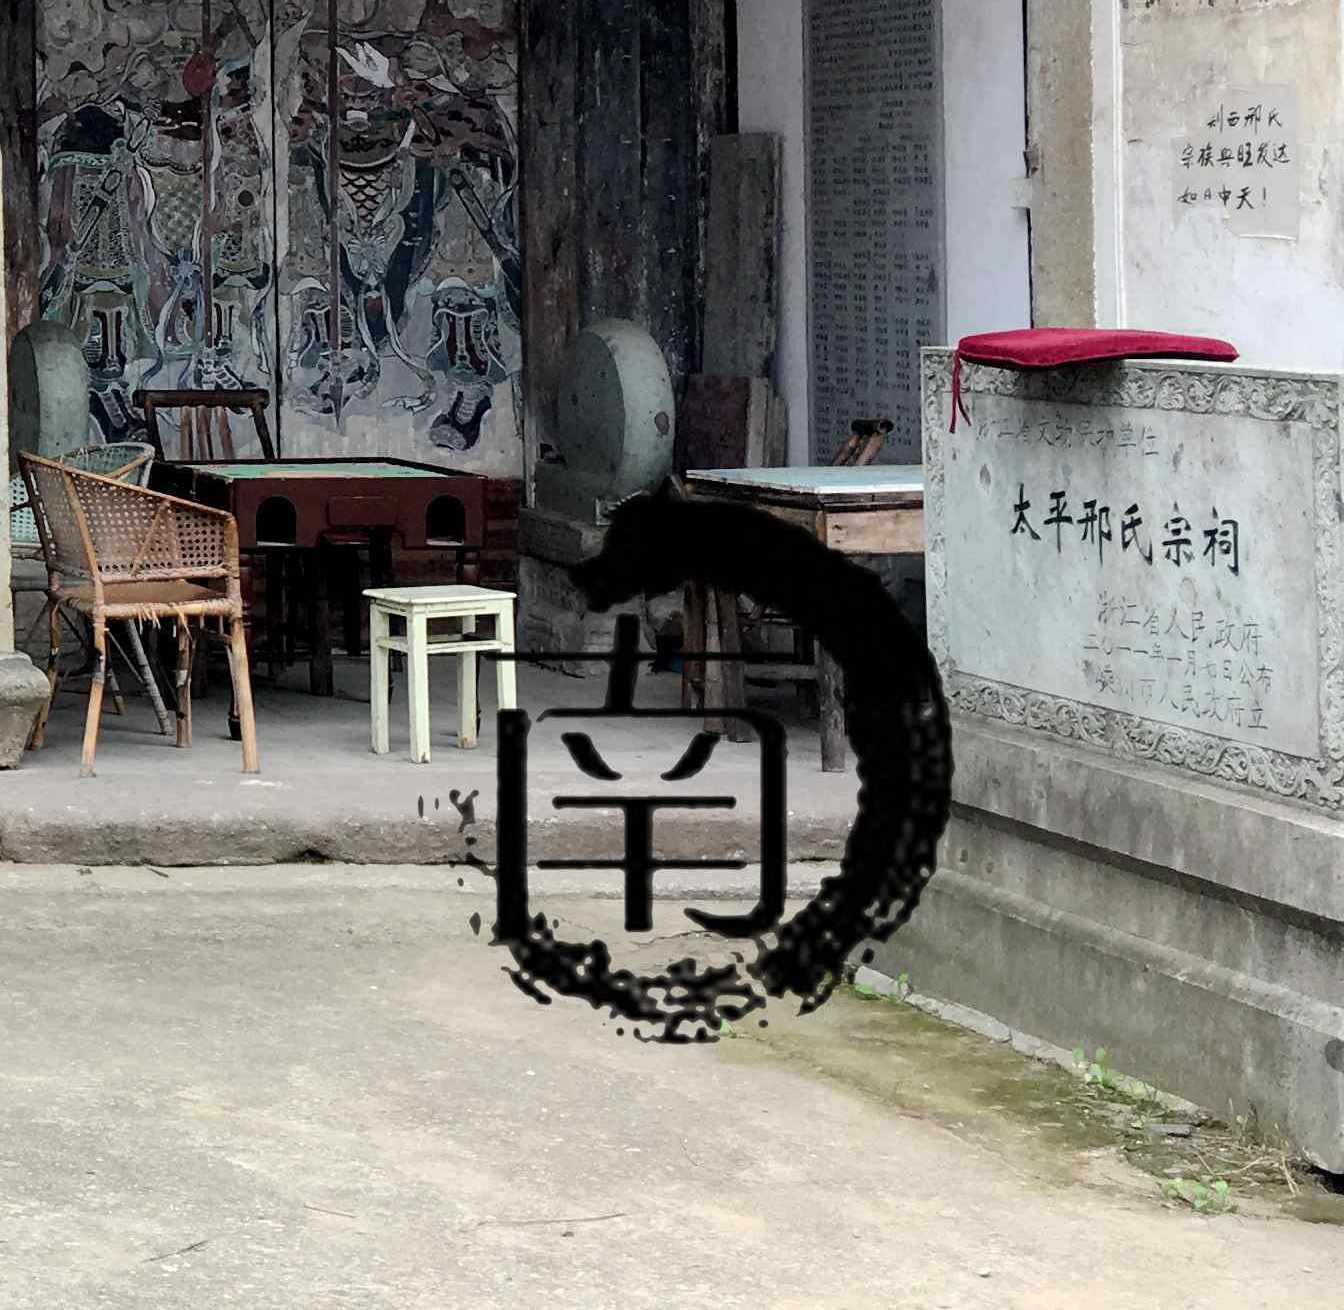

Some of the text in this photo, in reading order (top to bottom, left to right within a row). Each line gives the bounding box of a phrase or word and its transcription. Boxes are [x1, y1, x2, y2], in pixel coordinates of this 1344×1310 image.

[1011, 482, 1240, 577] 太平邢氏宗祠
